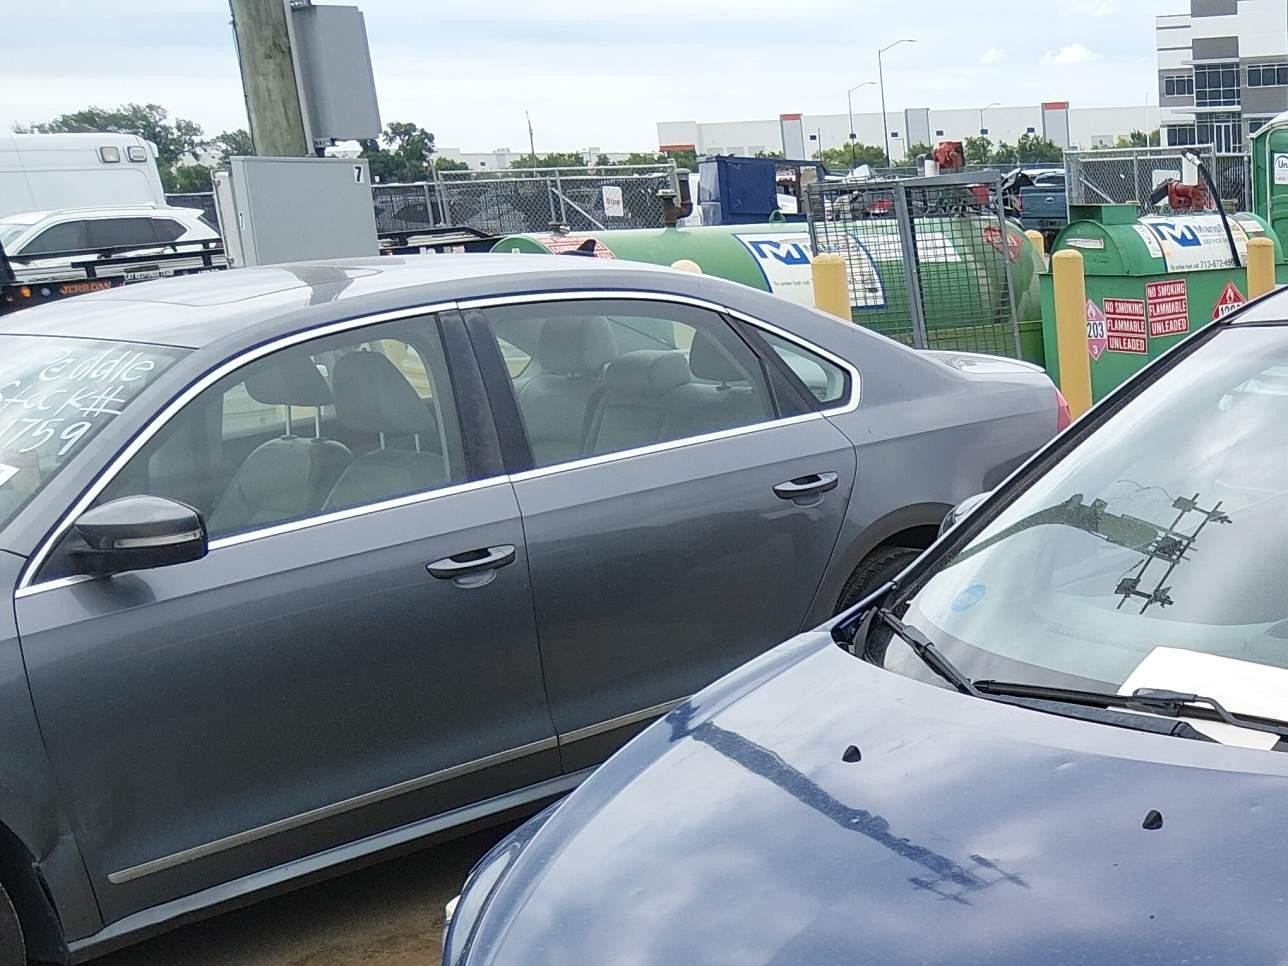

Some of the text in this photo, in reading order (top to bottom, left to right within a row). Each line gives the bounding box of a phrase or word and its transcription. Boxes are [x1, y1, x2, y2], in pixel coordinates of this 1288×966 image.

[354, 166, 362, 182] 7
[1147, 282, 1185, 298] NO SMOKING
[1105, 301, 1144, 315] NO SMOKING
[1149, 300, 1186, 317] FLAMMABLE
[1107, 319, 1145, 333] FLAMMABLE
[1151, 319, 1187, 335] UNLEADED
[1092, 344, 1099, 355] 3
[1109, 337, 1145, 352] UNLEADED
